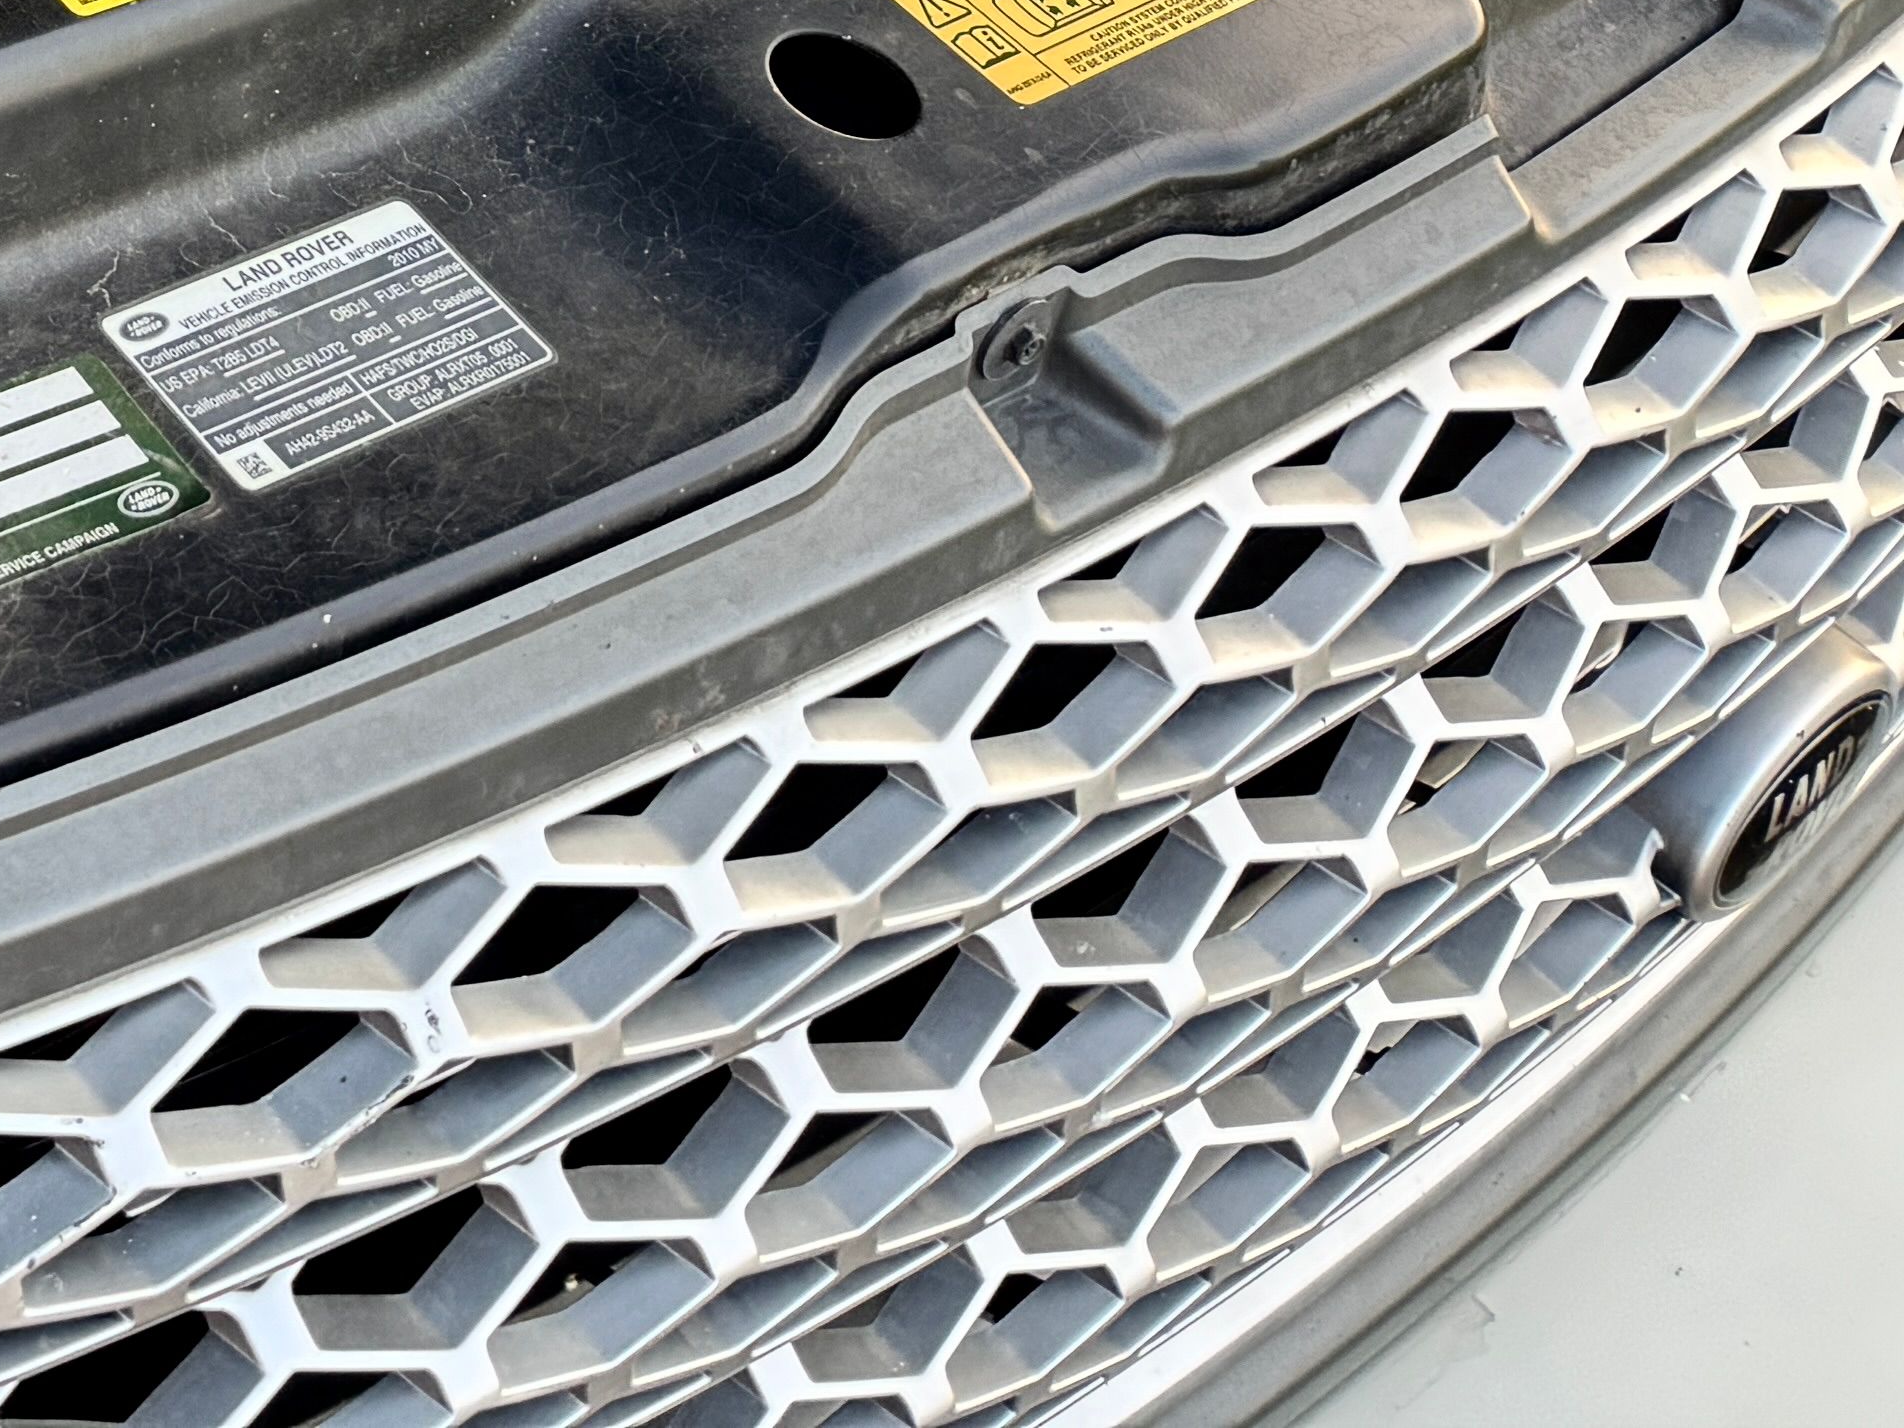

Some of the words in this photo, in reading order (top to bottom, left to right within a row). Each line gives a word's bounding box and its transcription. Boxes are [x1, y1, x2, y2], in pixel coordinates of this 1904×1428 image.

[1089, 19, 1131, 42] CAUTION
[1130, 2, 1166, 26] SYSTEM
[1153, 9, 1183, 30] UNDER
[1072, 63, 1088, 75] TO
[222, 259, 283, 292] LAND
[281, 230, 354, 267] ROVER
[388, 245, 420, 267] 2010
[416, 238, 441, 256] MY
[178, 301, 233, 330] VEHICLE
[234, 277, 290, 312] EMISSION
[290, 257, 347, 289] CONTROL
[347, 223, 427, 262] INFORMATION
[411, 260, 464, 288] Gasoline
[433, 284, 486, 312] Gasoline
[140, 334, 201, 369] Conforms
[201, 332, 214, 344] to
[159, 376, 182, 393] US
[243, 336, 280, 358] LDT4
[214, 432, 236, 448] No
[238, 403, 309, 439] adjustments
[308, 380, 354, 411] needed
[128, 486, 156, 504] LAND
[138, 491, 171, 511] ROVER
[43, 521, 120, 560] CAMPAIGN
[1764, 735, 1854, 843] LAND
